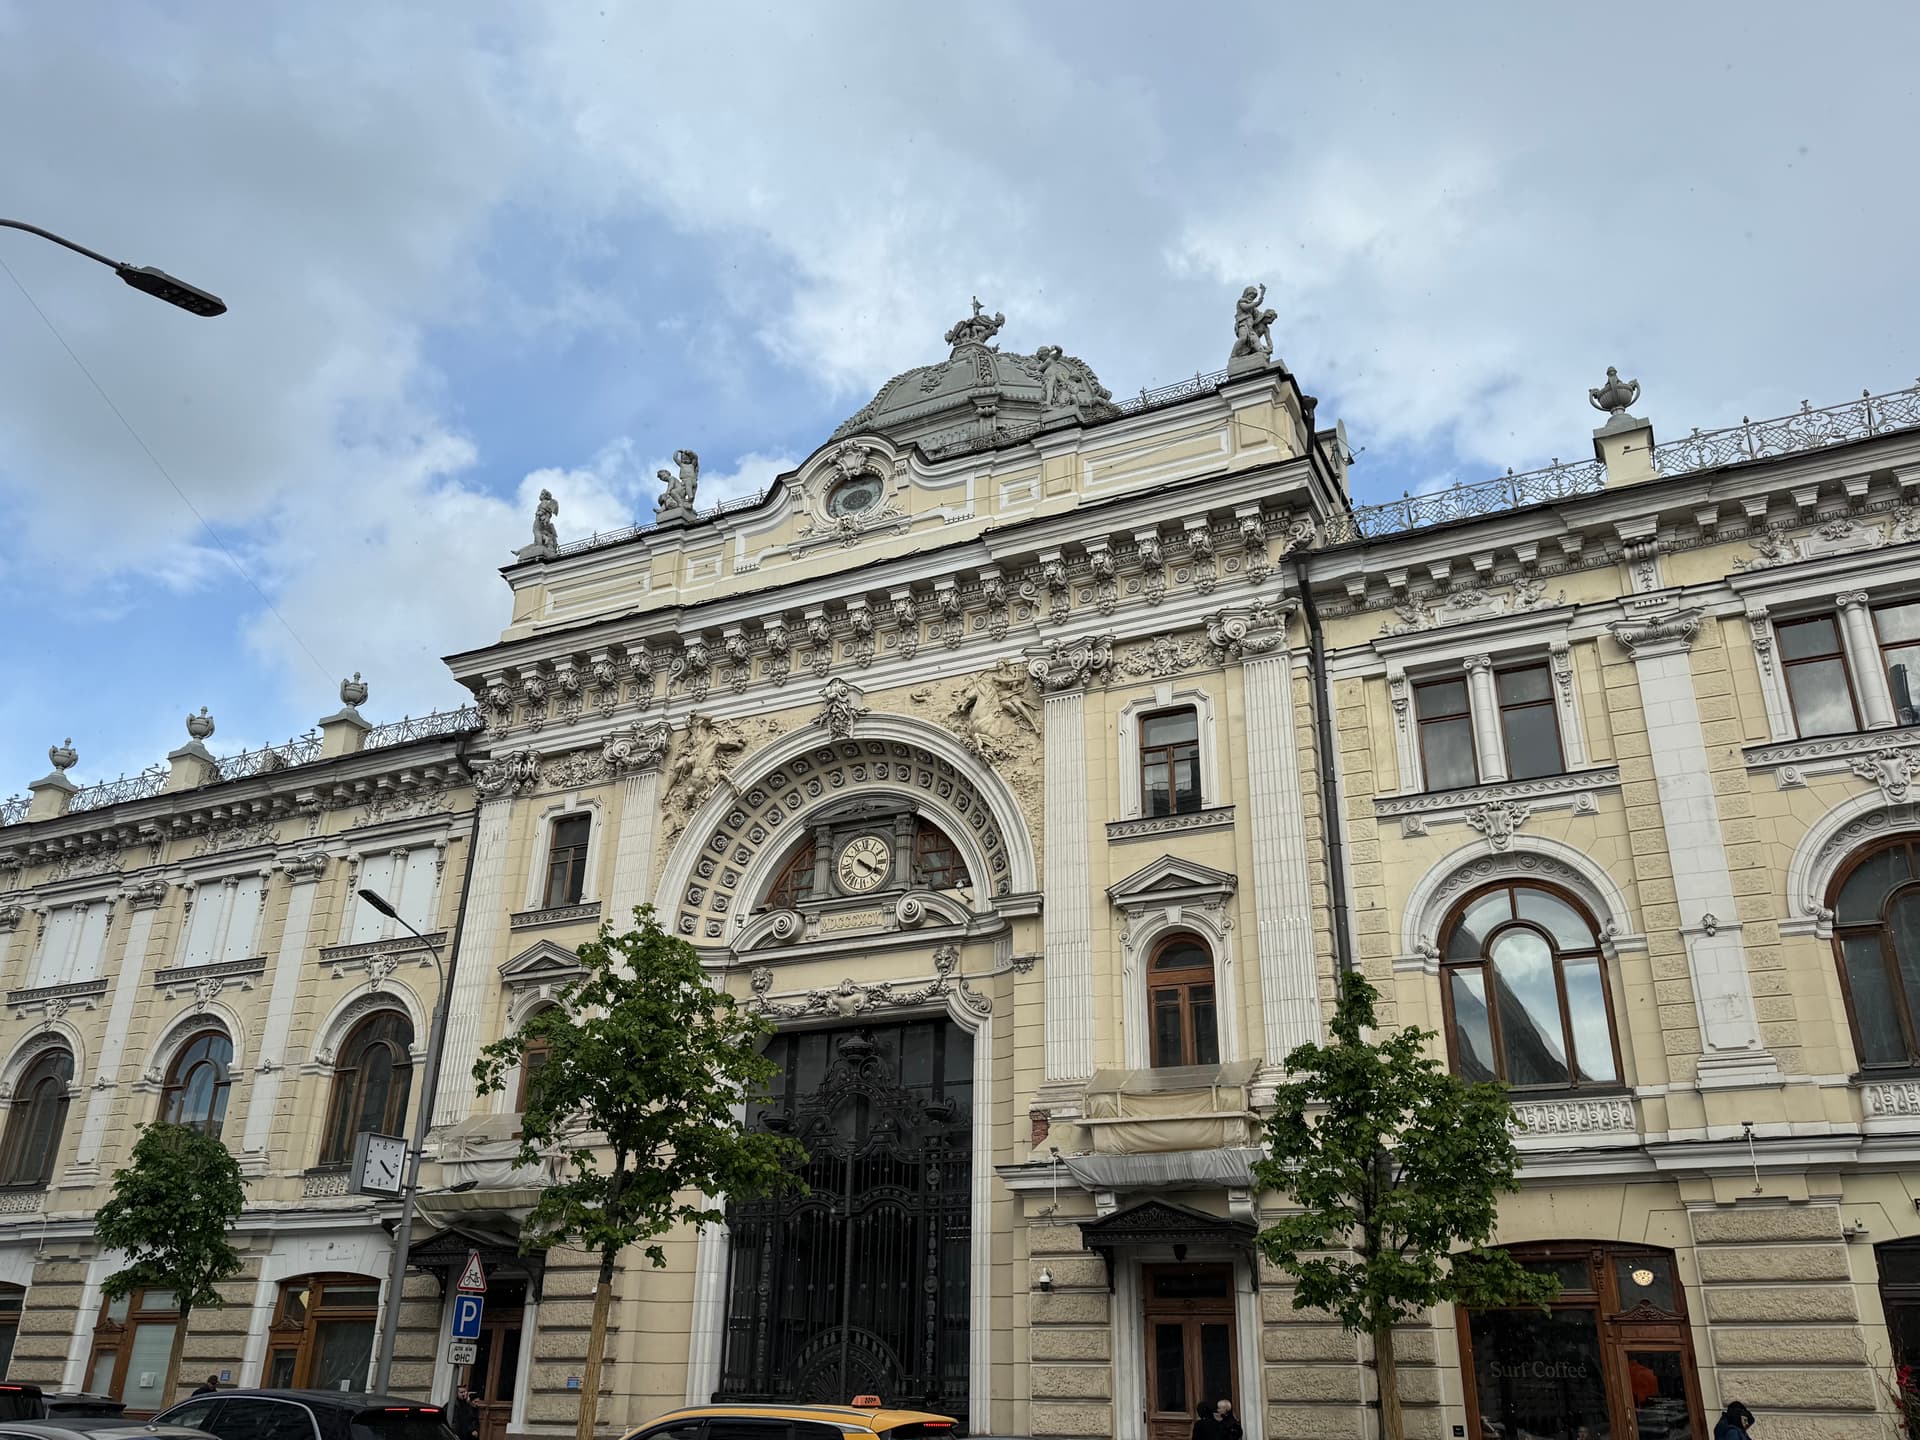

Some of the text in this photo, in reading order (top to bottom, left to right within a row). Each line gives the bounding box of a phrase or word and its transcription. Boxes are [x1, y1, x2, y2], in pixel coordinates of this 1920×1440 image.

[460, 1301, 477, 1333] P
[454, 1353, 471, 1363] ФНС
[1490, 1360, 1587, 1378] Surf Coffee
